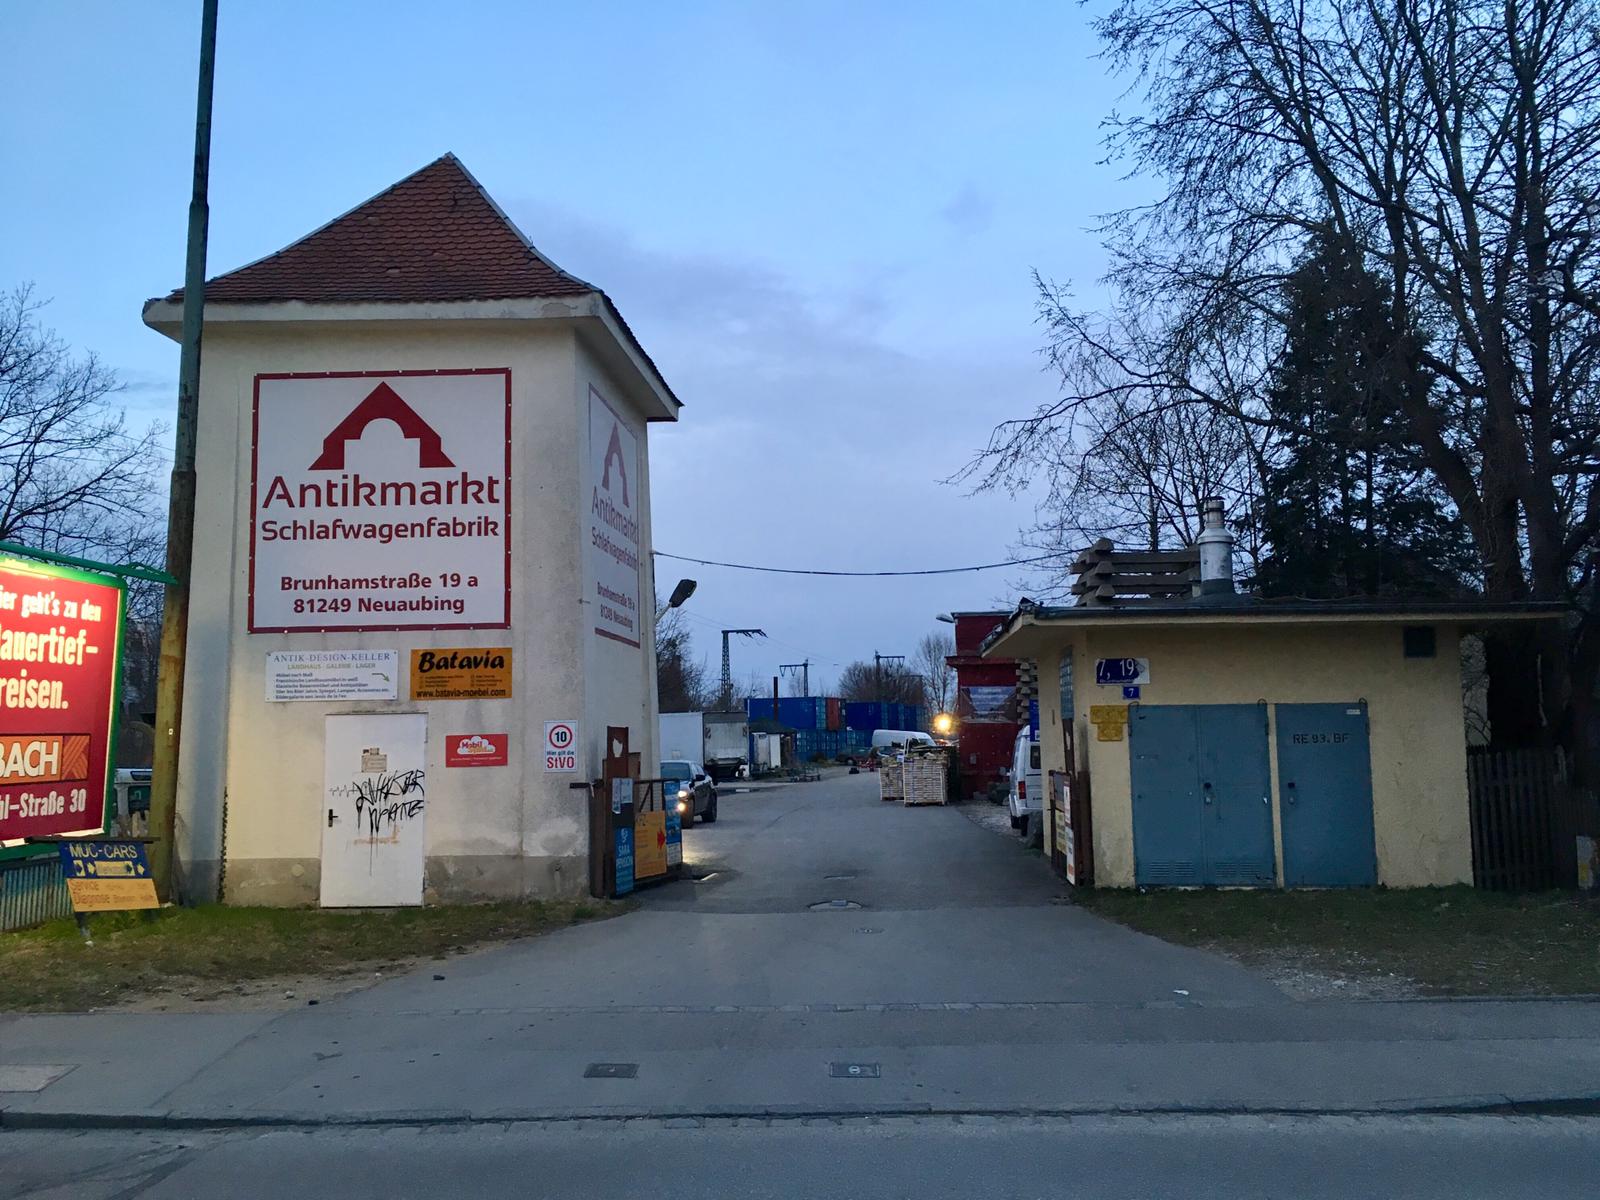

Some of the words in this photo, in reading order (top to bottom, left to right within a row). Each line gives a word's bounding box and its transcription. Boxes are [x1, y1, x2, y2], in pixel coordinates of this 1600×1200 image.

[262, 471, 500, 509] Antikmarkt
[261, 516, 499, 544] Schlafwagenfabrik
[280, 573, 432, 591] Brunhamstraße
[439, 573, 461, 588] 19
[467, 576, 479, 587] a
[21, 591, 60, 618] geht's
[63, 600, 78, 619] zu
[81, 599, 102, 622] den
[293, 597, 351, 613] 81249
[358, 596, 465, 614] Neuaubing
[0, 623, 99, 666] auertief-
[418, 650, 505, 673] Batavia
[1119, 659, 1135, 677] 19
[1128, 688, 1135, 697] 7
[555, 731, 567, 742] 10
[1293, 733, 1309, 745] RE
[547, 756, 575, 769] StVO
[69, 788, 87, 813] 30
[69, 843, 138, 859] MUC-CARS
